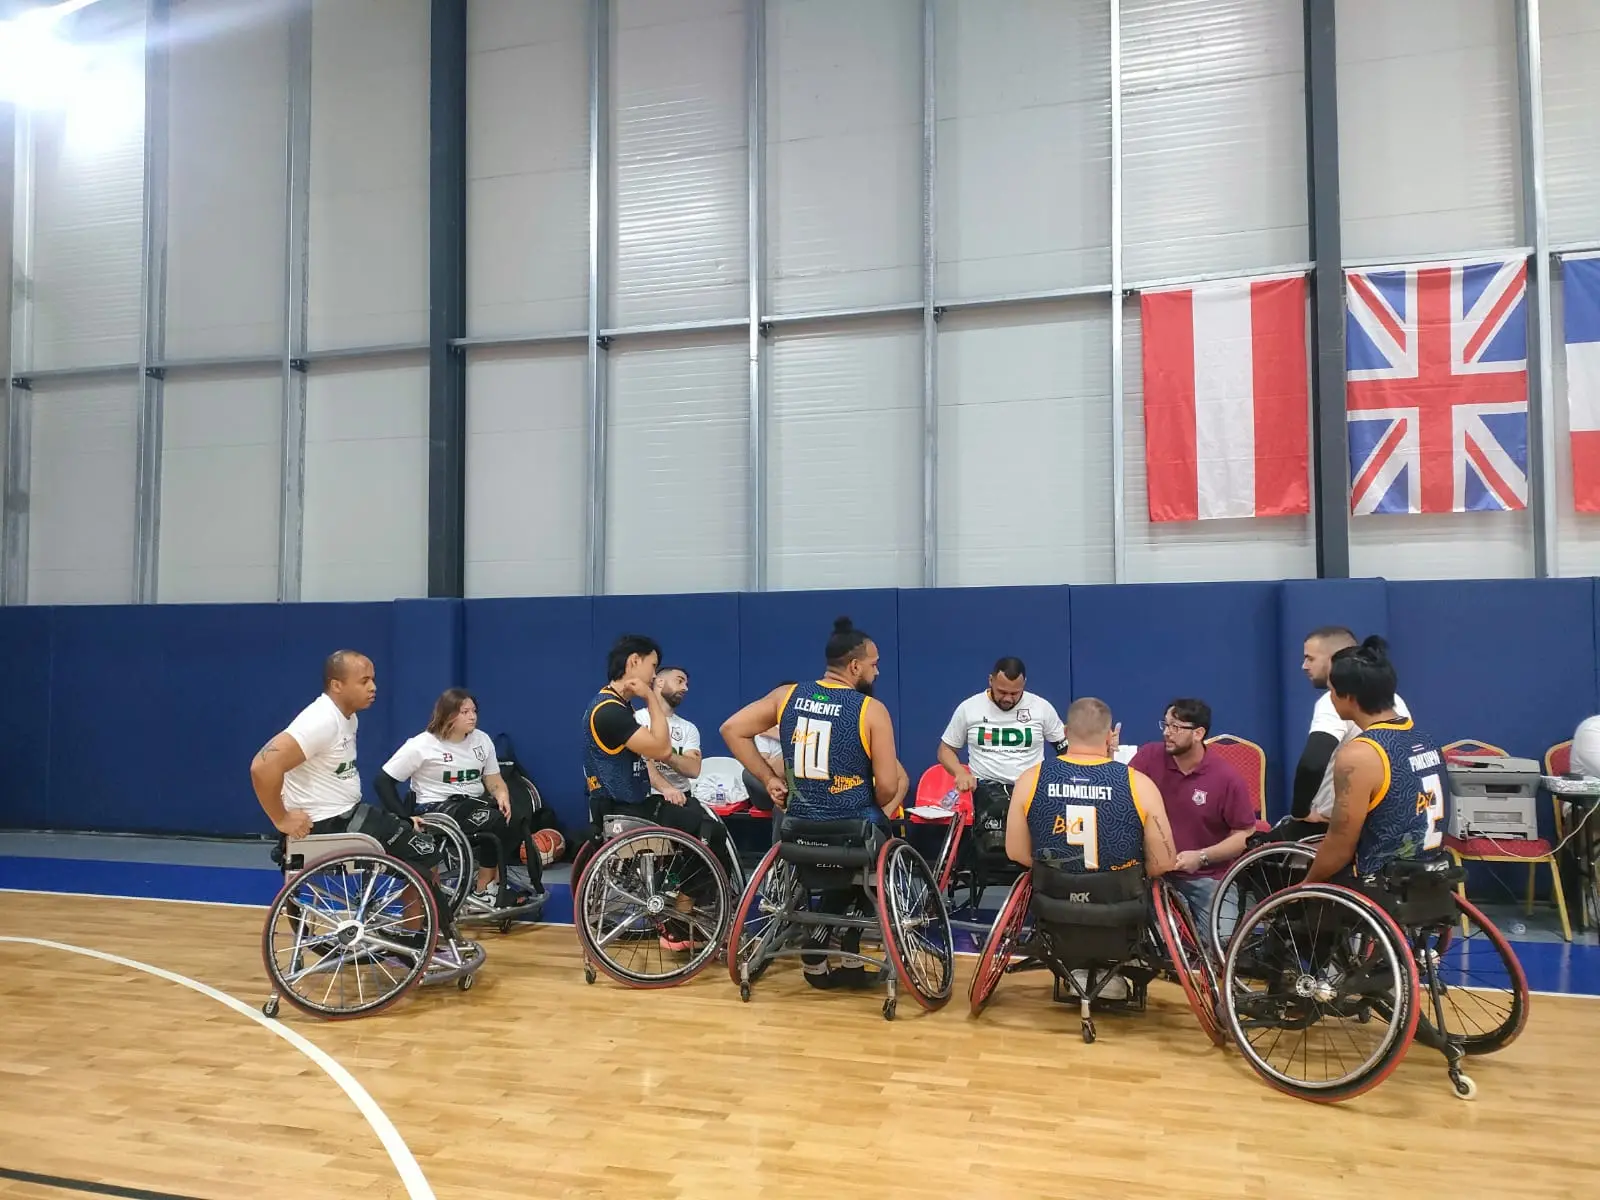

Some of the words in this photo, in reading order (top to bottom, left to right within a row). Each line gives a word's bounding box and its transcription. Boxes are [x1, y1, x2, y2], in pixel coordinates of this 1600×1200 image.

[794, 698, 842, 716] CLEMENTE
[977, 727, 1032, 747] HDI
[794, 716, 832, 780] 10
[1048, 784, 1112, 800] BLOMQUIST
[1066, 804, 1098, 869] 9
